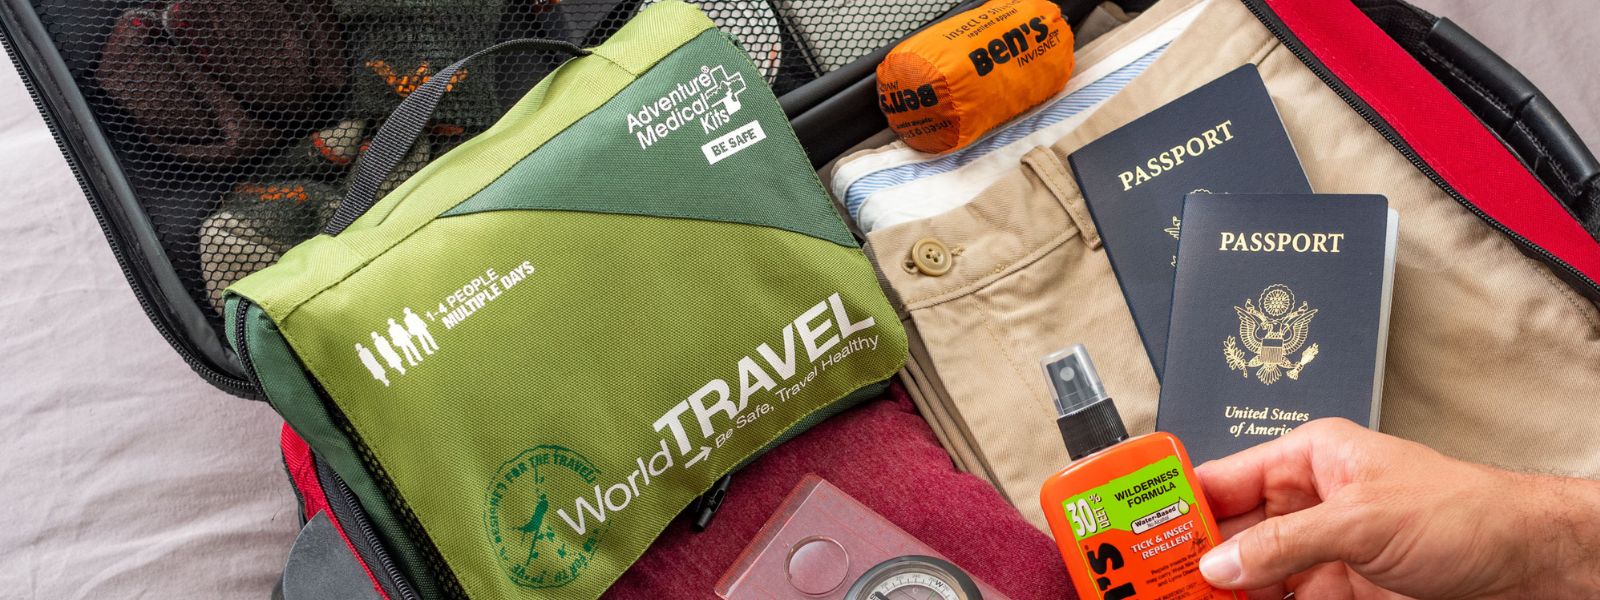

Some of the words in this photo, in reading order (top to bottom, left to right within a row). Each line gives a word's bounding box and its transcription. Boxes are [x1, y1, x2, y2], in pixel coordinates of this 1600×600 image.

[942, 18, 980, 40] insect
[967, 20, 996, 39] repellent
[996, 8, 1018, 22] apparel
[968, 16, 1049, 77] Ben's
[880, 83, 939, 114] Ben's
[636, 93, 709, 150] Medical
[700, 108, 730, 135] Kits
[711, 141, 727, 157] BE
[730, 128, 757, 149] SAFE
[1118, 120, 1235, 191] PASSPORT
[1219, 231, 1345, 253] PASSPORT
[427, 303, 448, 321] 1-4
[446, 267, 499, 308] PEOPLE
[441, 283, 502, 330] MULTIPLE
[501, 260, 535, 290] DAYS
[715, 428, 734, 449] Be
[736, 403, 774, 430] Safe,
[775, 366, 818, 402] Travel
[822, 335, 879, 371] Healthy
[557, 439, 673, 536] World
[652, 292, 876, 456] TRAVEL
[1224, 406, 1269, 420] United
[1270, 408, 1310, 422] States
[1229, 421, 1246, 438] of
[1244, 422, 1294, 436] Americ
[1114, 468, 1180, 502] WILDERNESS
[1127, 481, 1177, 508] FORMULA
[1134, 505, 1176, 528] Water-Based
[1131, 538, 1154, 553] TICK
[1155, 535, 1163, 543] &
[1163, 520, 1195, 540] INSECT
[1142, 532, 1193, 560] REPELLENT
